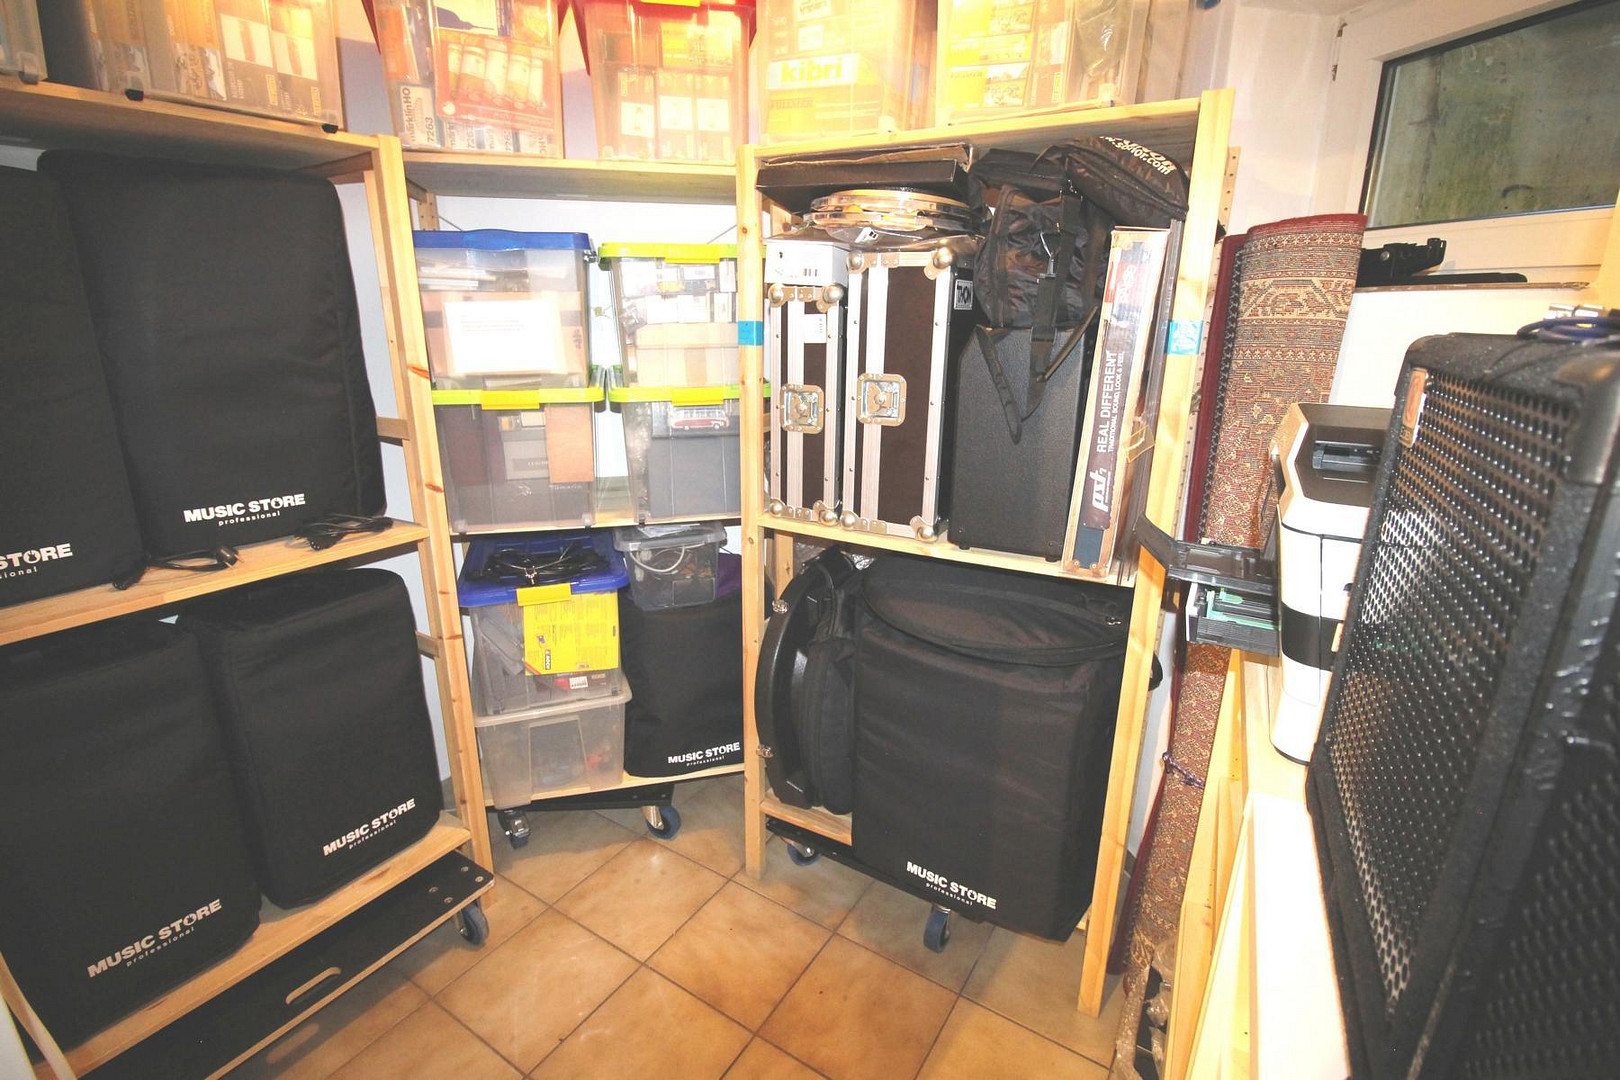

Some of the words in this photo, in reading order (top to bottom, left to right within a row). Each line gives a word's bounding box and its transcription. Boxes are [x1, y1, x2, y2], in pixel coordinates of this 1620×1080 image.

[780, 57, 843, 82] kibri
[425, 117, 435, 142] 7263
[1100, 350, 1118, 418] DIFFERENT
[1096, 421, 1110, 453] REAL
[183, 503, 246, 522] MUSIC
[248, 493, 306, 513] STORE
[218, 511, 281, 527] professional
[667, 750, 704, 764] MUSIC
[705, 742, 741, 758] STORE
[686, 755, 725, 767] professional
[323, 824, 370, 857] MUSIC
[371, 798, 416, 829] STORE
[348, 820, 397, 850] professional
[906, 861, 948, 888] MUSIC
[949, 881, 997, 910] STORE
[925, 882, 973, 906] professional
[87, 935, 156, 978] MUSIC
[158, 899, 222, 940] STORE
[126, 926, 195, 968] professional
